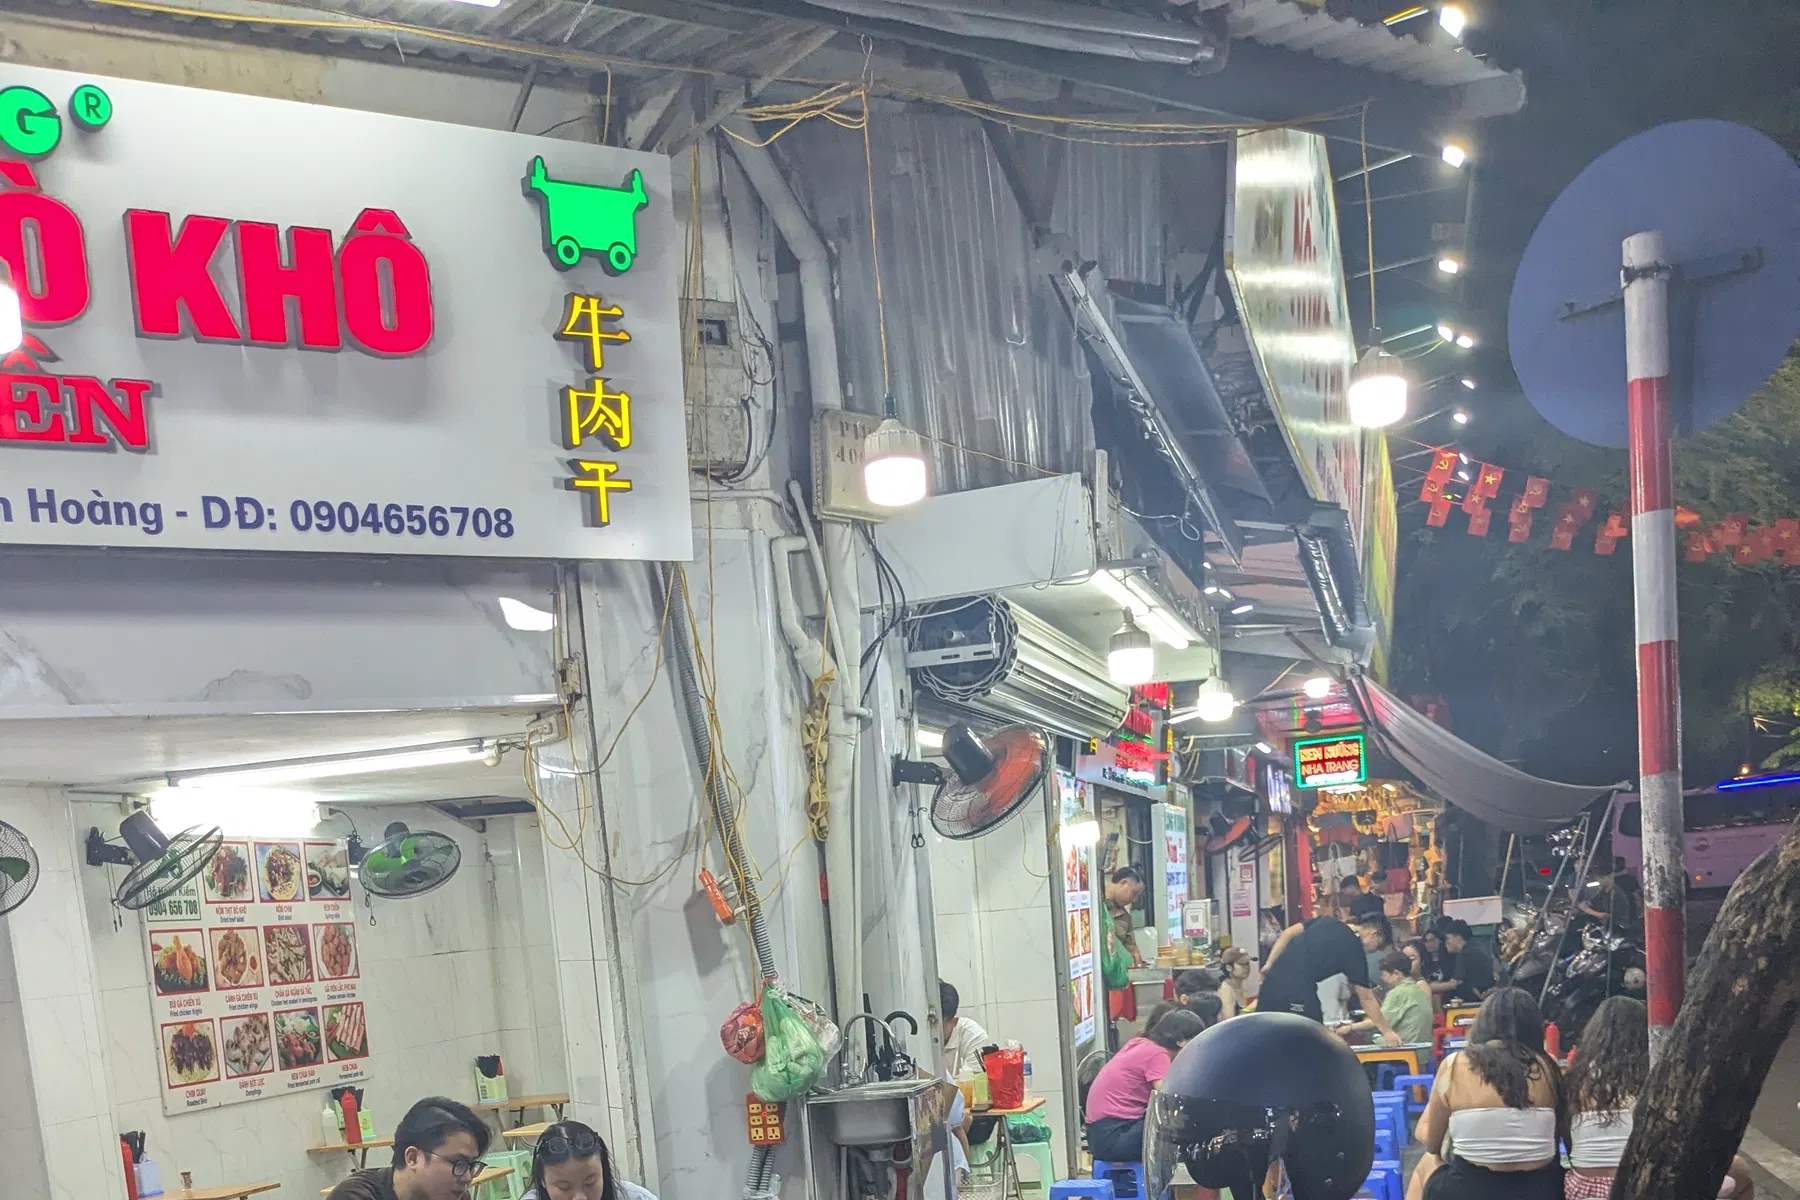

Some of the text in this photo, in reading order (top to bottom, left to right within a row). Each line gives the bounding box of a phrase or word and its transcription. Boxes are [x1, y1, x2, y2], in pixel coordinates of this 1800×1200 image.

[123, 207, 435, 358] KHÔ
[558, 293, 632, 526] 牛肉干
[27, 488, 164, 535] Hoàng
[201, 495, 277, 531] DĐ:
[290, 499, 515, 538] 0904656708
[1325, 759, 1359, 774] TRANG
[168, 900, 184, 915] 656
[184, 899, 199, 915] 708
